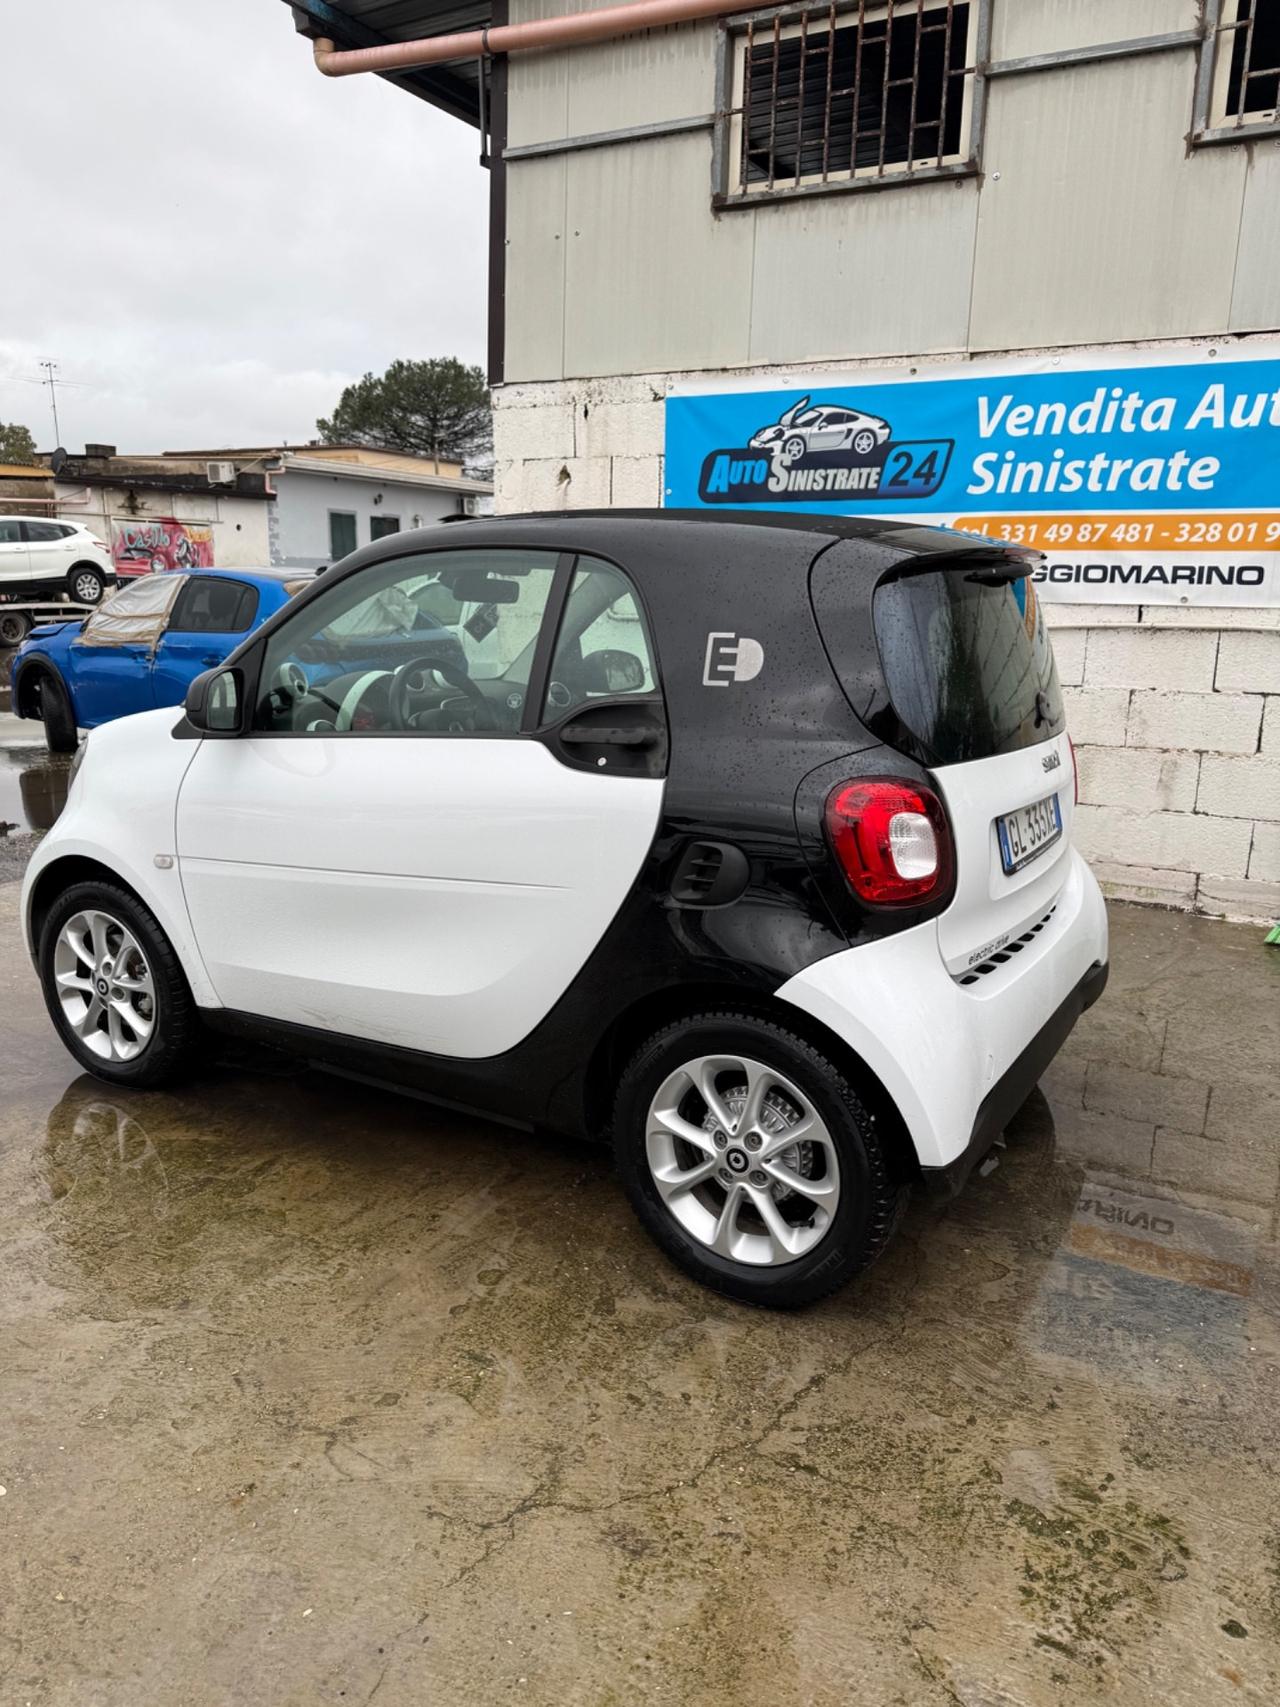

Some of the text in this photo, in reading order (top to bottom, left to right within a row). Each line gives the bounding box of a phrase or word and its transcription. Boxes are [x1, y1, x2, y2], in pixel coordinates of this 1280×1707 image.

[978, 387, 1177, 438] Vendita
[888, 450, 938, 487] 24
[966, 449, 1221, 495] Sinistrate
[1000, 523, 1038, 543] 331
[1044, 523, 1075, 543] 49
[1076, 523, 1108, 543] 87
[1110, 522, 1154, 543] 481
[1174, 522, 1223, 543] 328
[1227, 522, 1258, 543] 01
